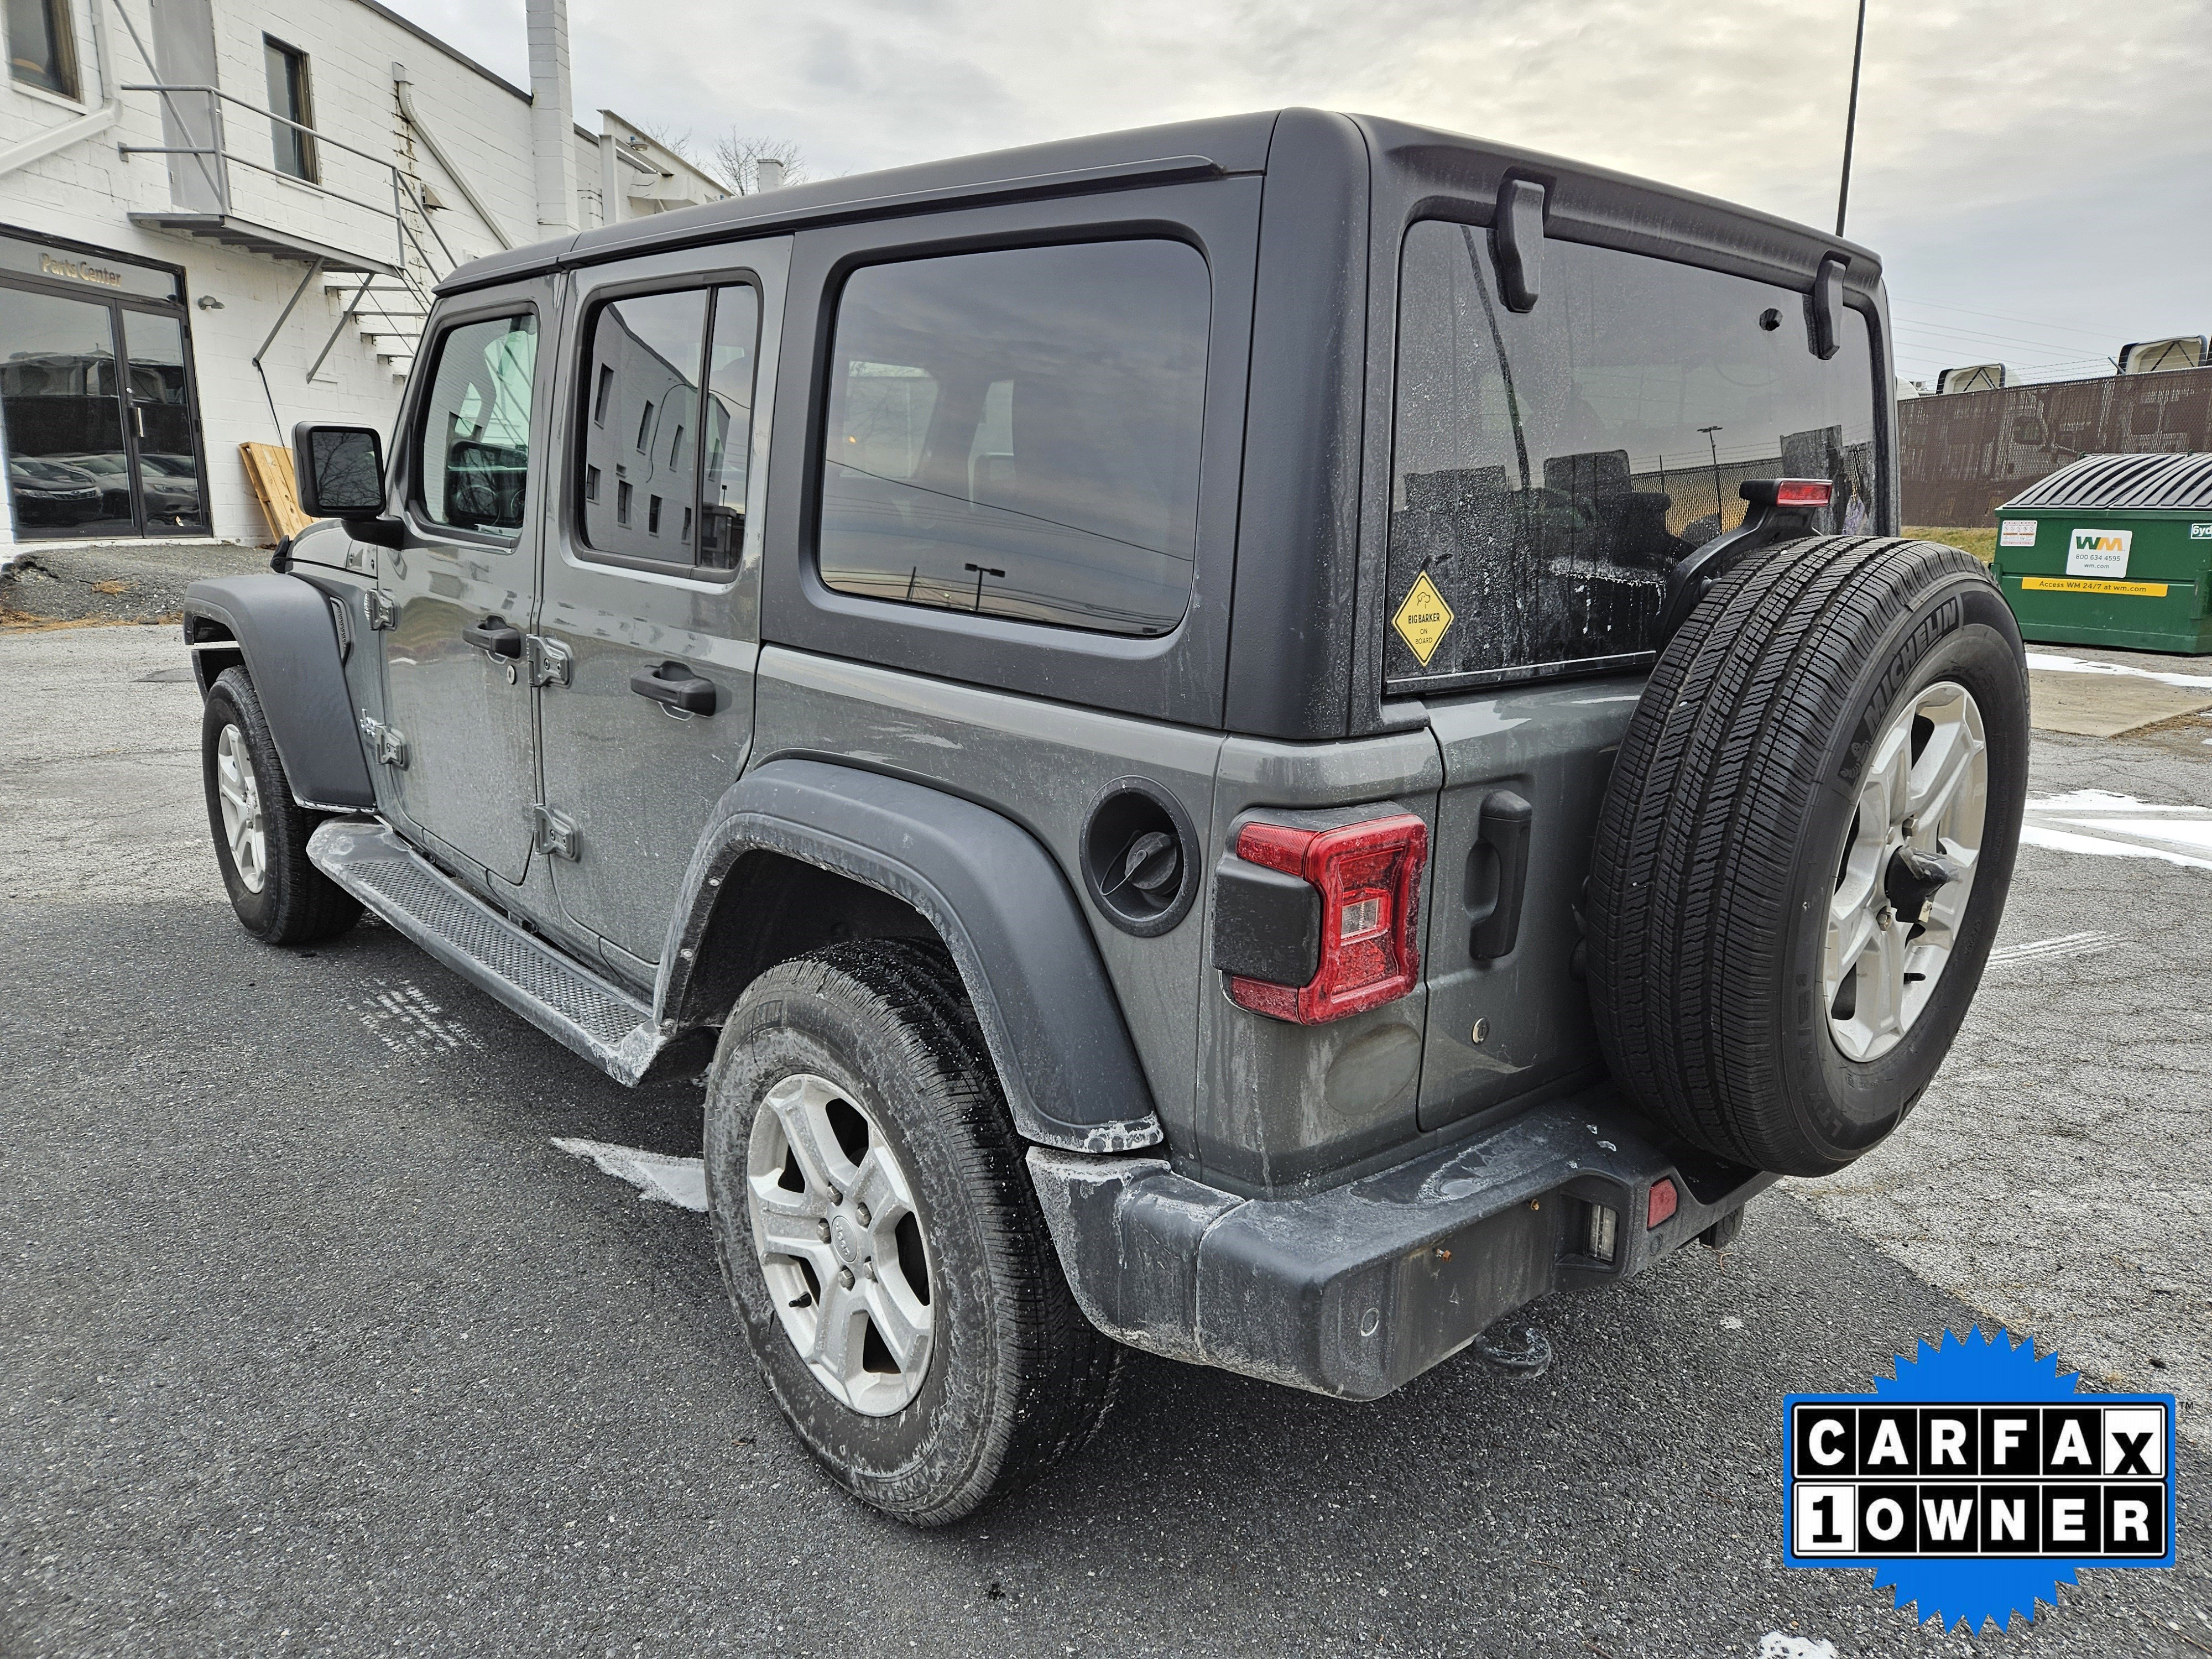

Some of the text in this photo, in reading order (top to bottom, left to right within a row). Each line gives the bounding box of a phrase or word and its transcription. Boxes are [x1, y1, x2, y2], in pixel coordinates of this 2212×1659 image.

[41, 252, 121, 287] Parts Center
[2076, 536, 2123, 551] WM
[1408, 613, 1440, 624] BIG BARKER
[1863, 598, 1957, 732] MICHELIN
